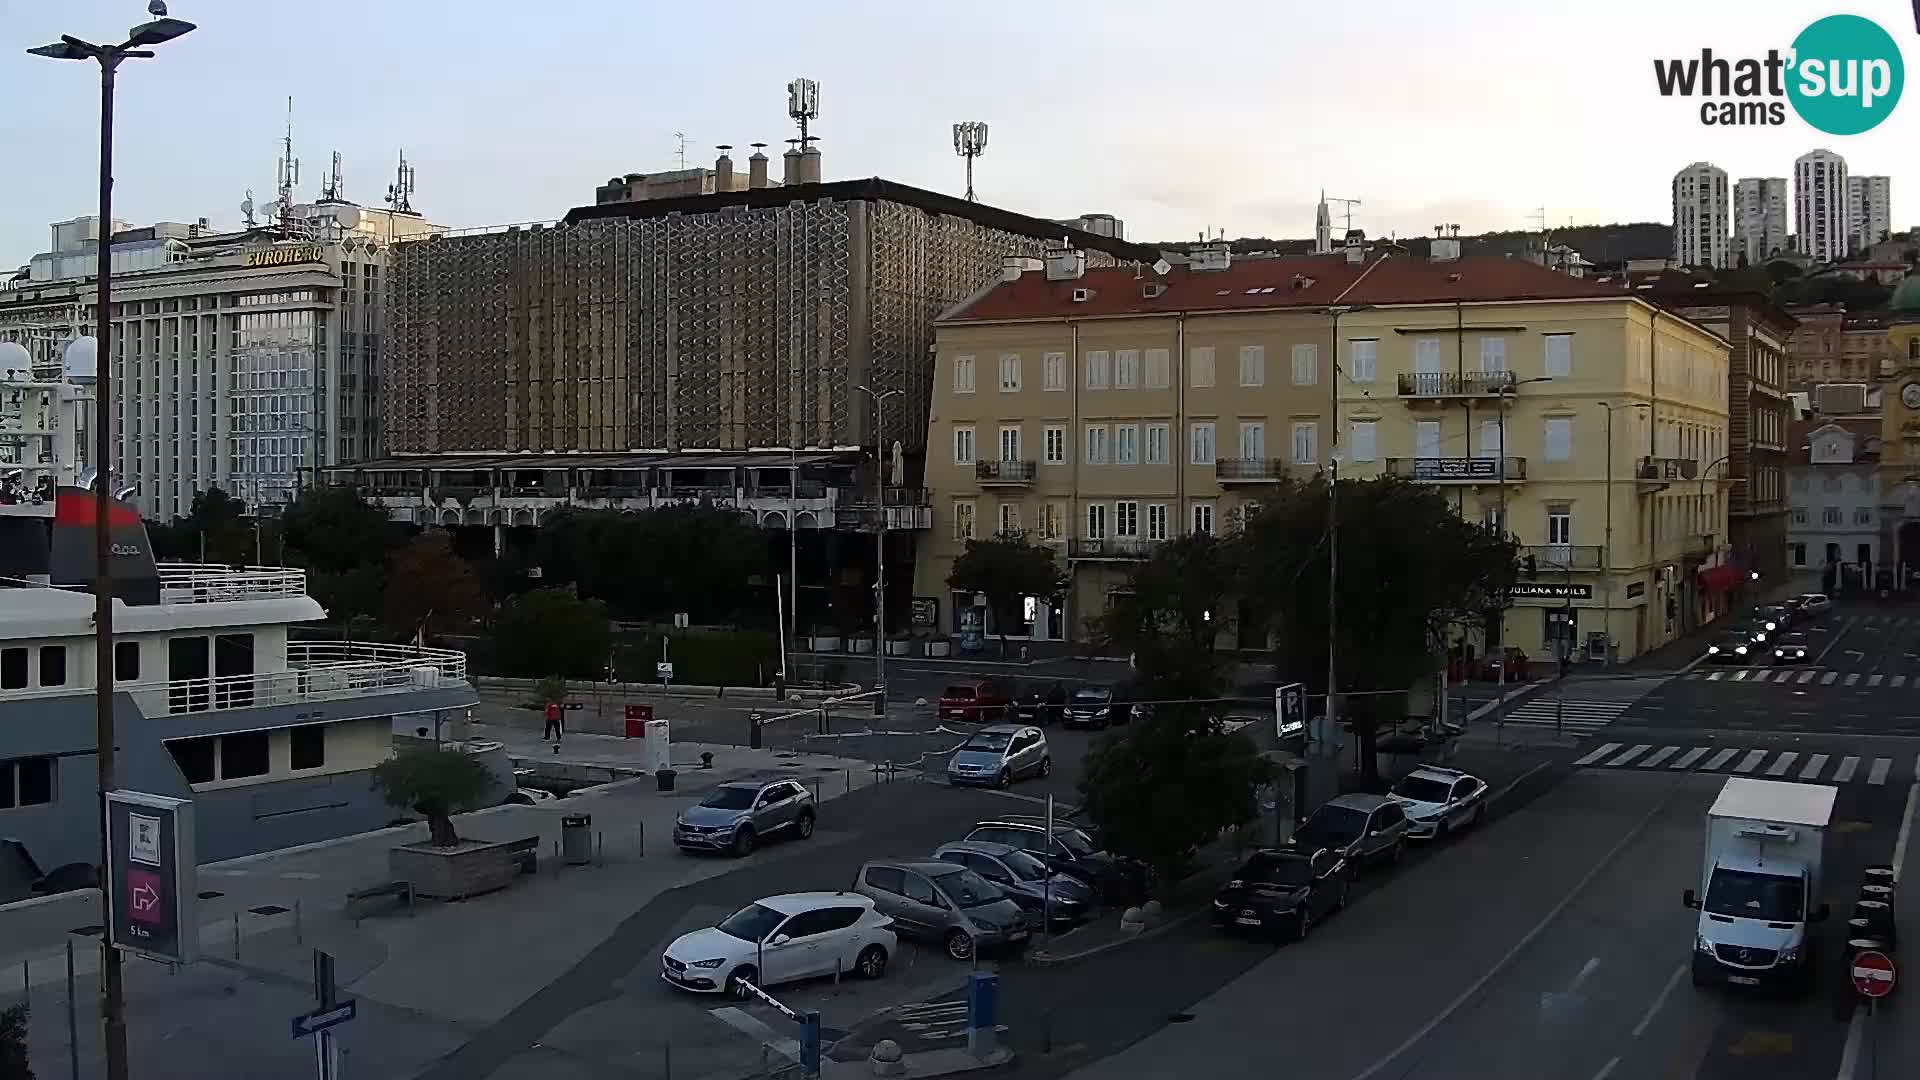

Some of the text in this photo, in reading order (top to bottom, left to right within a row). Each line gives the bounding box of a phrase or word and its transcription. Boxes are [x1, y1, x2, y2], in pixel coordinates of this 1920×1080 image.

[1508, 586, 1587, 596] JULIANA NAILS
[130, 925, 150, 937] 5 km
